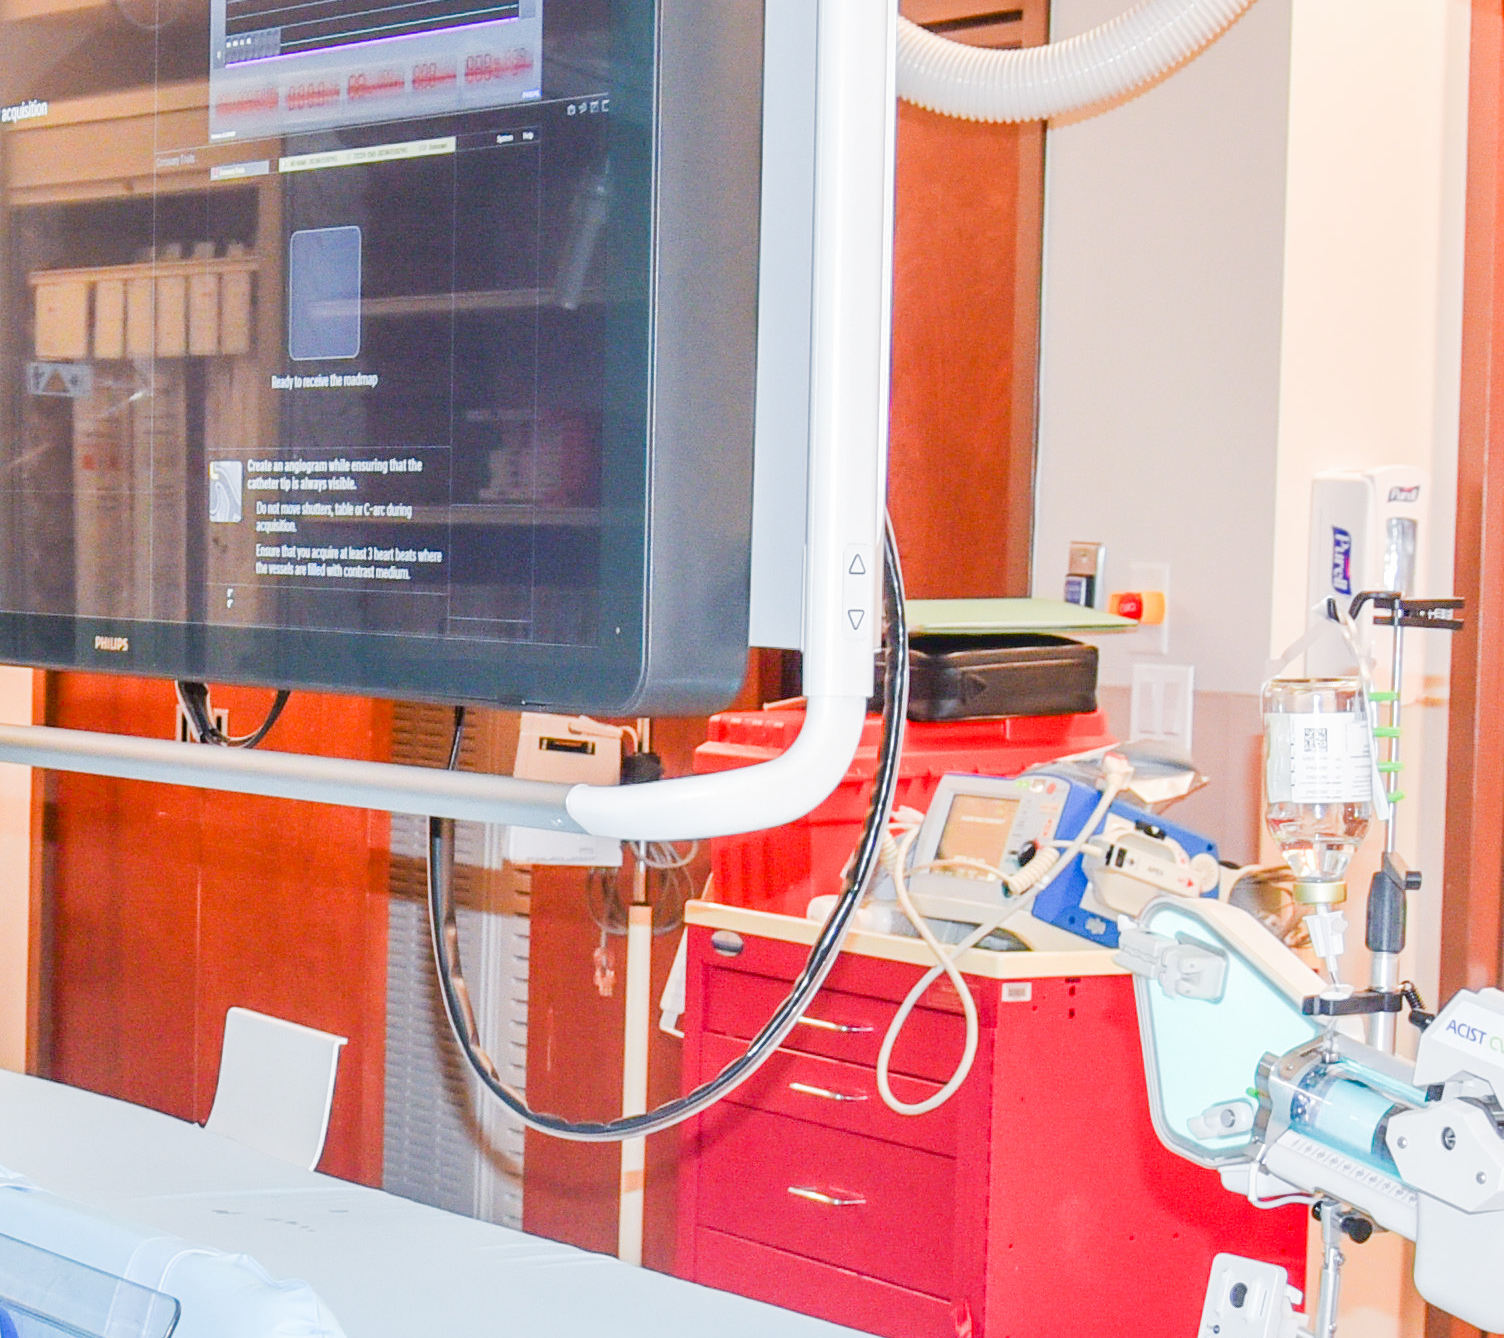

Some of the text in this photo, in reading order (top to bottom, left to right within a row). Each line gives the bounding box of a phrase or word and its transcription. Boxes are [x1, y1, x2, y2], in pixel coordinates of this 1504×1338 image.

[1, 99, 48, 124] acquisition
[272, 372, 378, 390] Ready to receive the roadmap
[247, 458, 423, 474] Create an angiogram while ensuring that the
[247, 476, 357, 492] catheter tip is always visible.
[256, 501, 412, 519] Do not move shutters, table or C-arc during
[256, 519, 297, 534] acquisition.
[256, 544, 442, 563] Ensure that you acquire at least 3 heart beats where
[256, 562, 411, 580] the vessels are filled with contrast medium.
[1334, 533, 1349, 593] Purell
[95, 635, 128, 651] PHILIPS
[1445, 1019, 1487, 1045] ACIST
